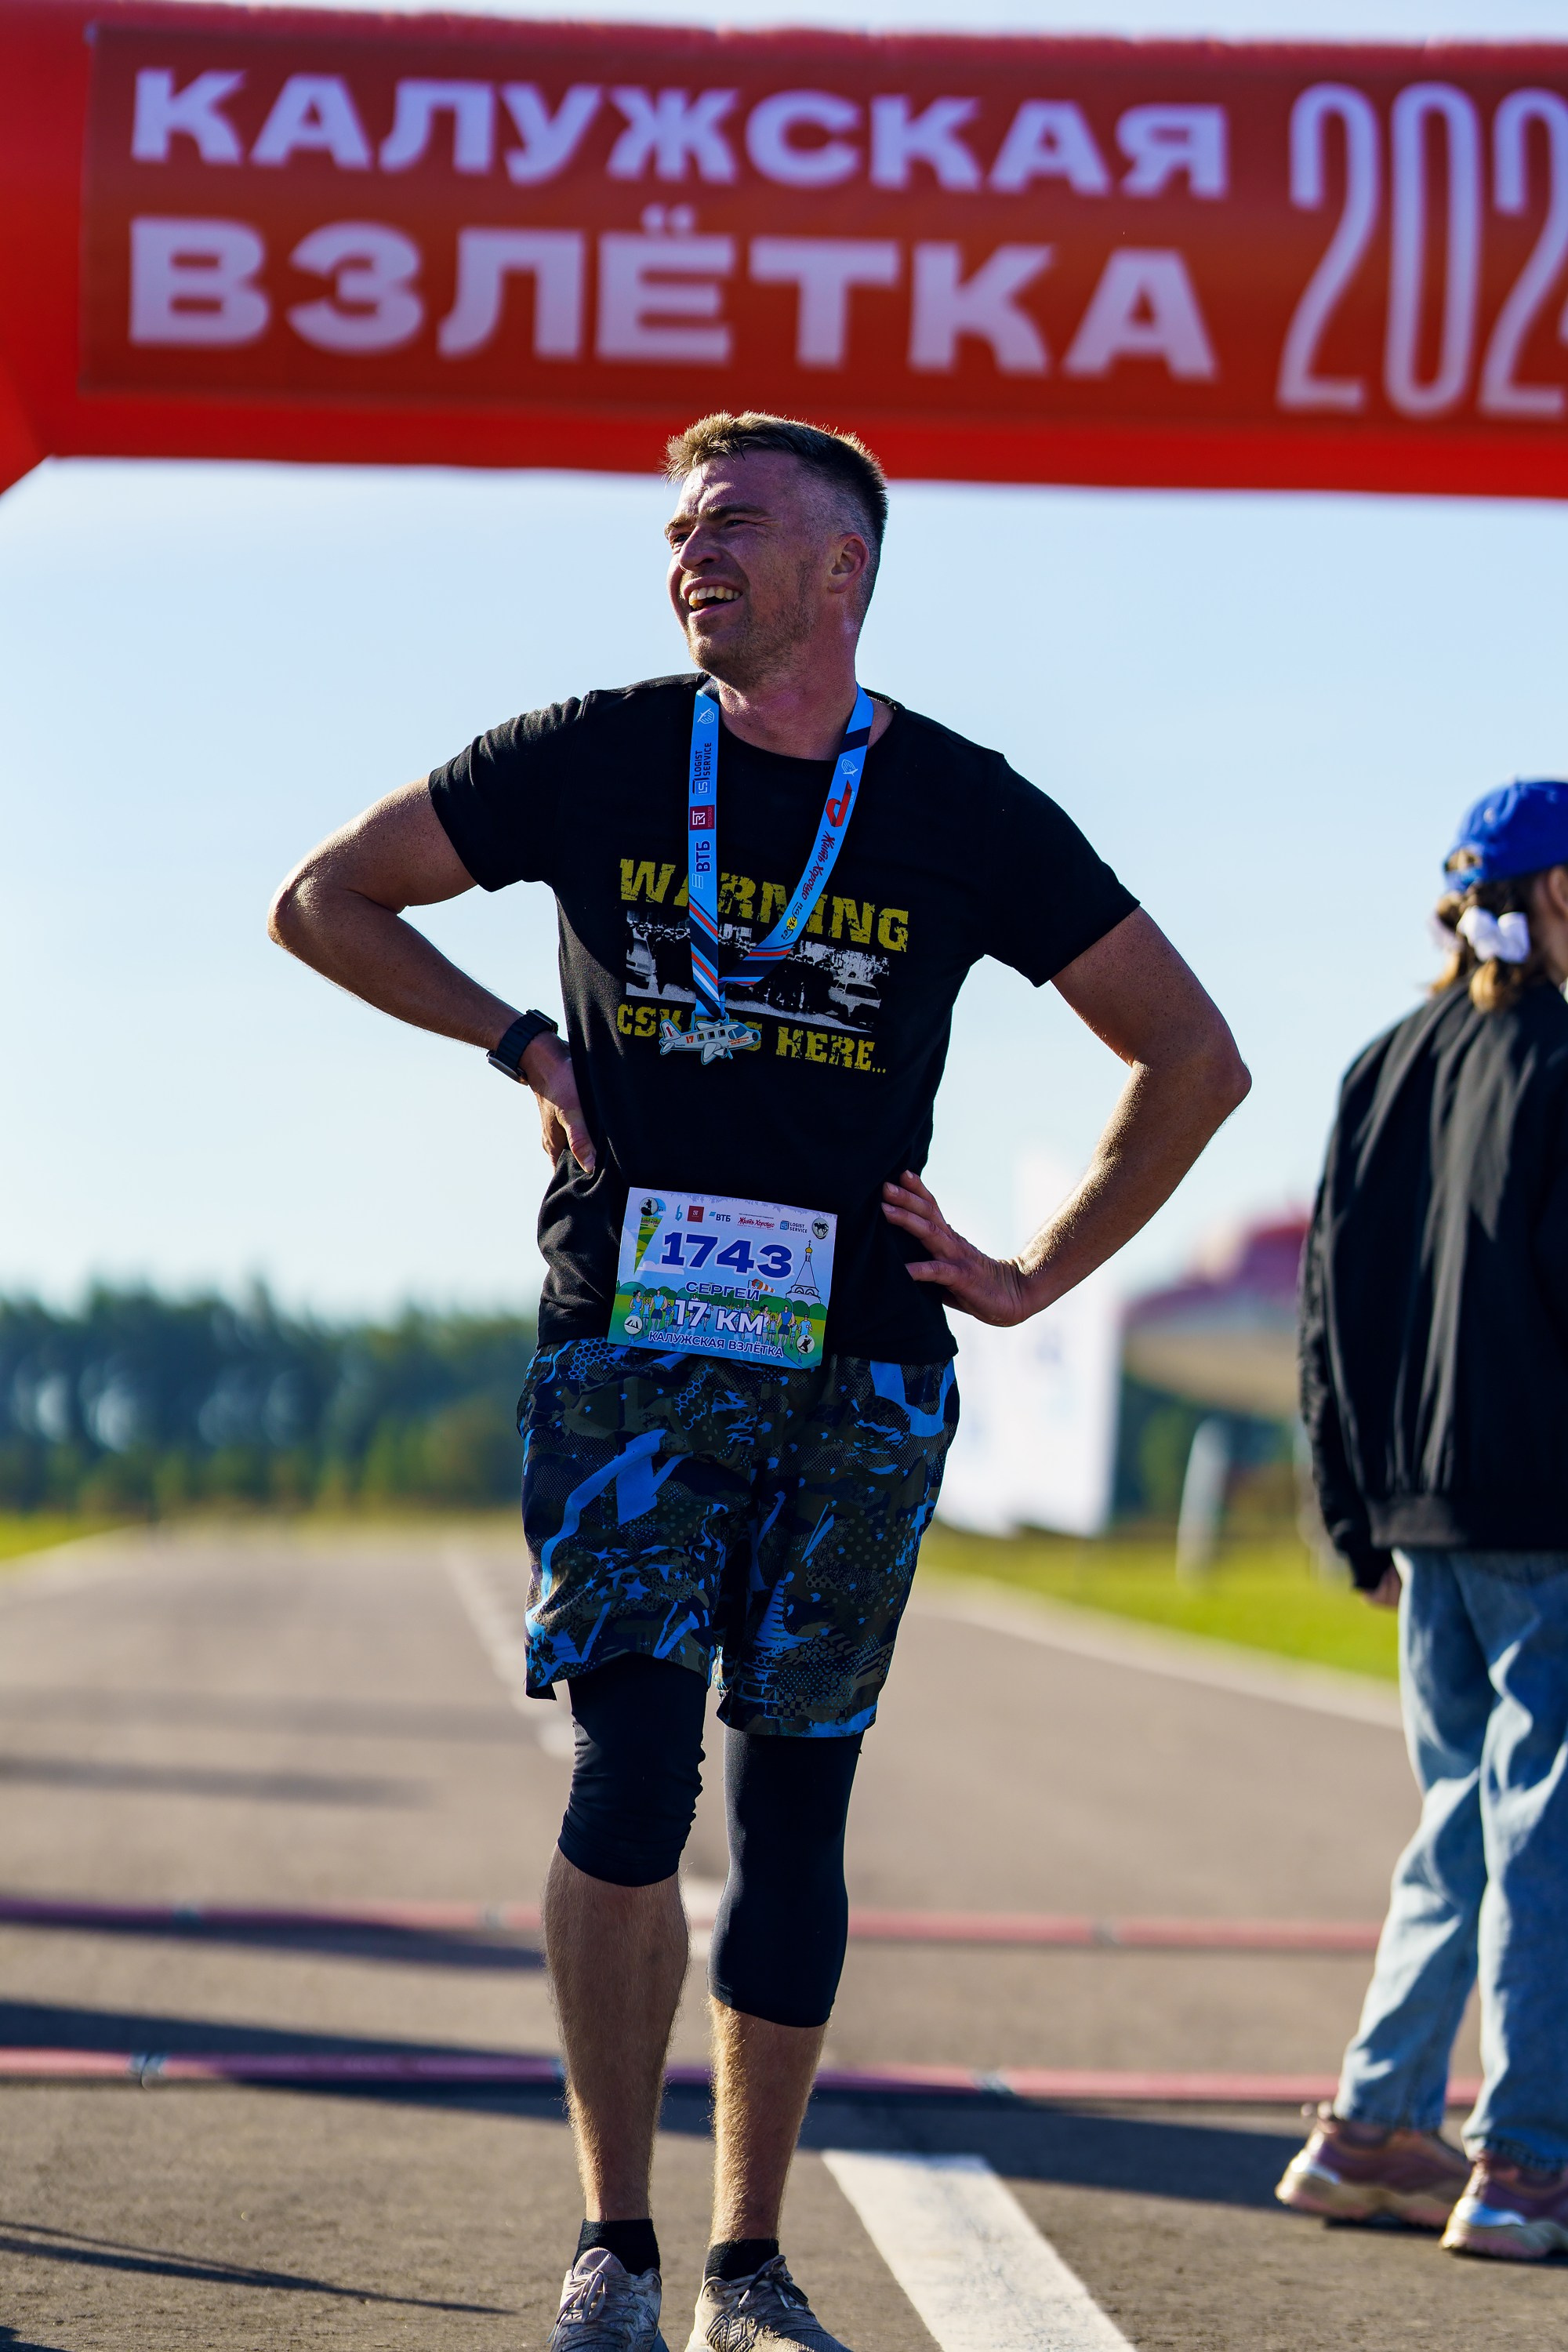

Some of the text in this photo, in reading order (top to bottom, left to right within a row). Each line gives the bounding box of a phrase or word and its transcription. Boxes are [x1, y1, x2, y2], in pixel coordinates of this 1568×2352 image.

[132, 68, 1227, 199] КАЛУЖСКАЯ
[1277, 82, 1568, 419] 202
[129, 204, 1218, 382] ВЗЛЁТКА
[694, 750, 702, 777] LOGIST
[703, 742, 712, 776] SERVICE
[695, 840, 711, 873] ВТБ
[716, 1214, 731, 1222] ВТБ
[661, 1232, 793, 1279] 1743
[686, 1281, 760, 1301] СЕРГЕЙ
[674, 1298, 766, 1336] 17 КМ
[648, 1331, 784, 1357] КАЛУЖСКАЯ ВЗЛЁТКА
